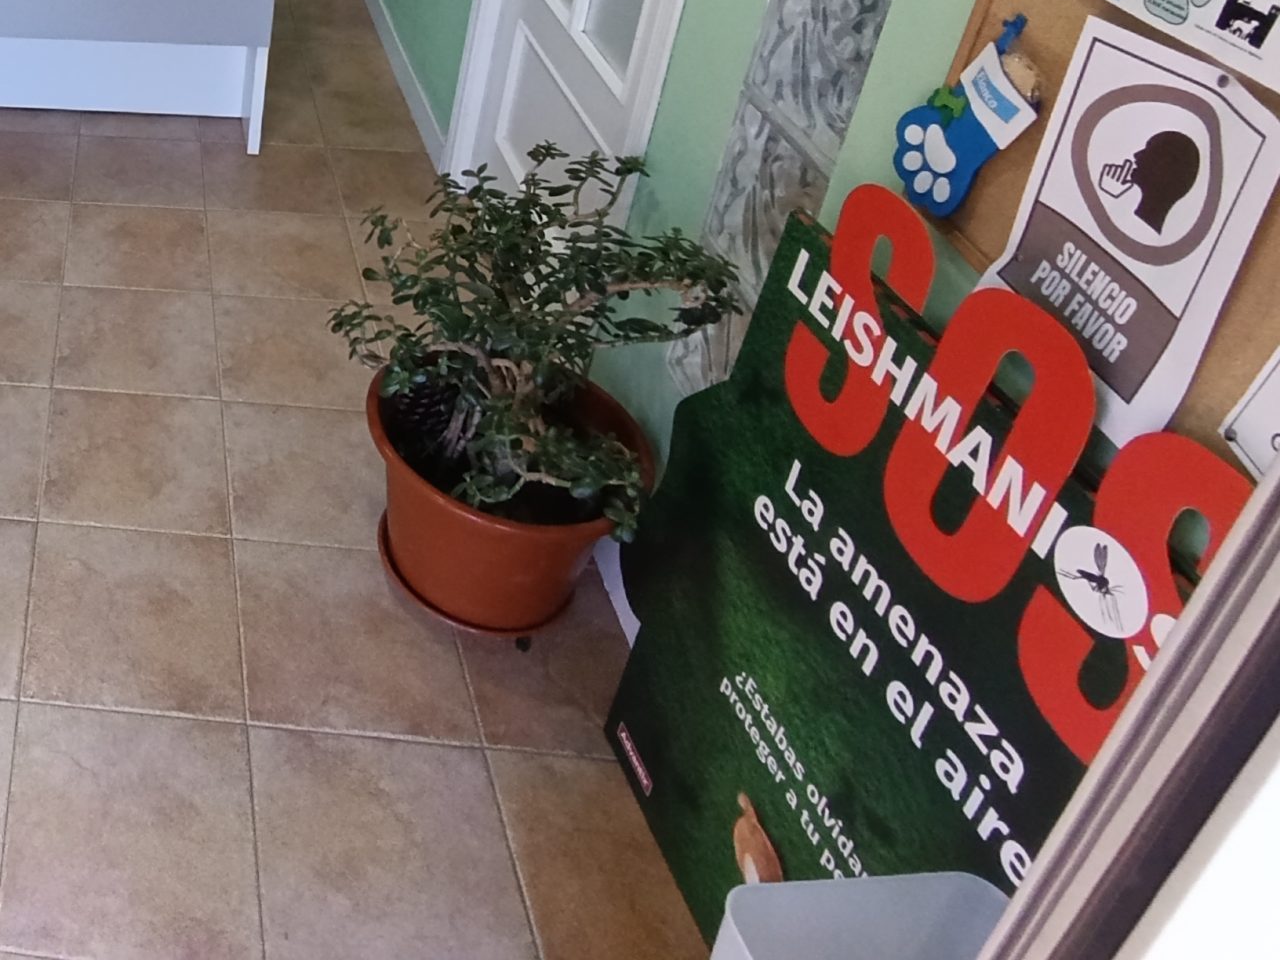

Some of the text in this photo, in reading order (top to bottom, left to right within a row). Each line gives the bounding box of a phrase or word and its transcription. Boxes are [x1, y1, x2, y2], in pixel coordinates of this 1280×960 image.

[1030, 259, 1128, 363] POR FAVOR
[1056, 241, 1138, 325] SILENCIO
[753, 495, 1032, 890] está en el aire
[784, 458, 1025, 794] La amenaza
[720, 676, 786, 783] proteger
[785, 788, 798, 810] a
[800, 809, 821, 846] tu
[735, 671, 869, 878] ¿Estabas olvida
